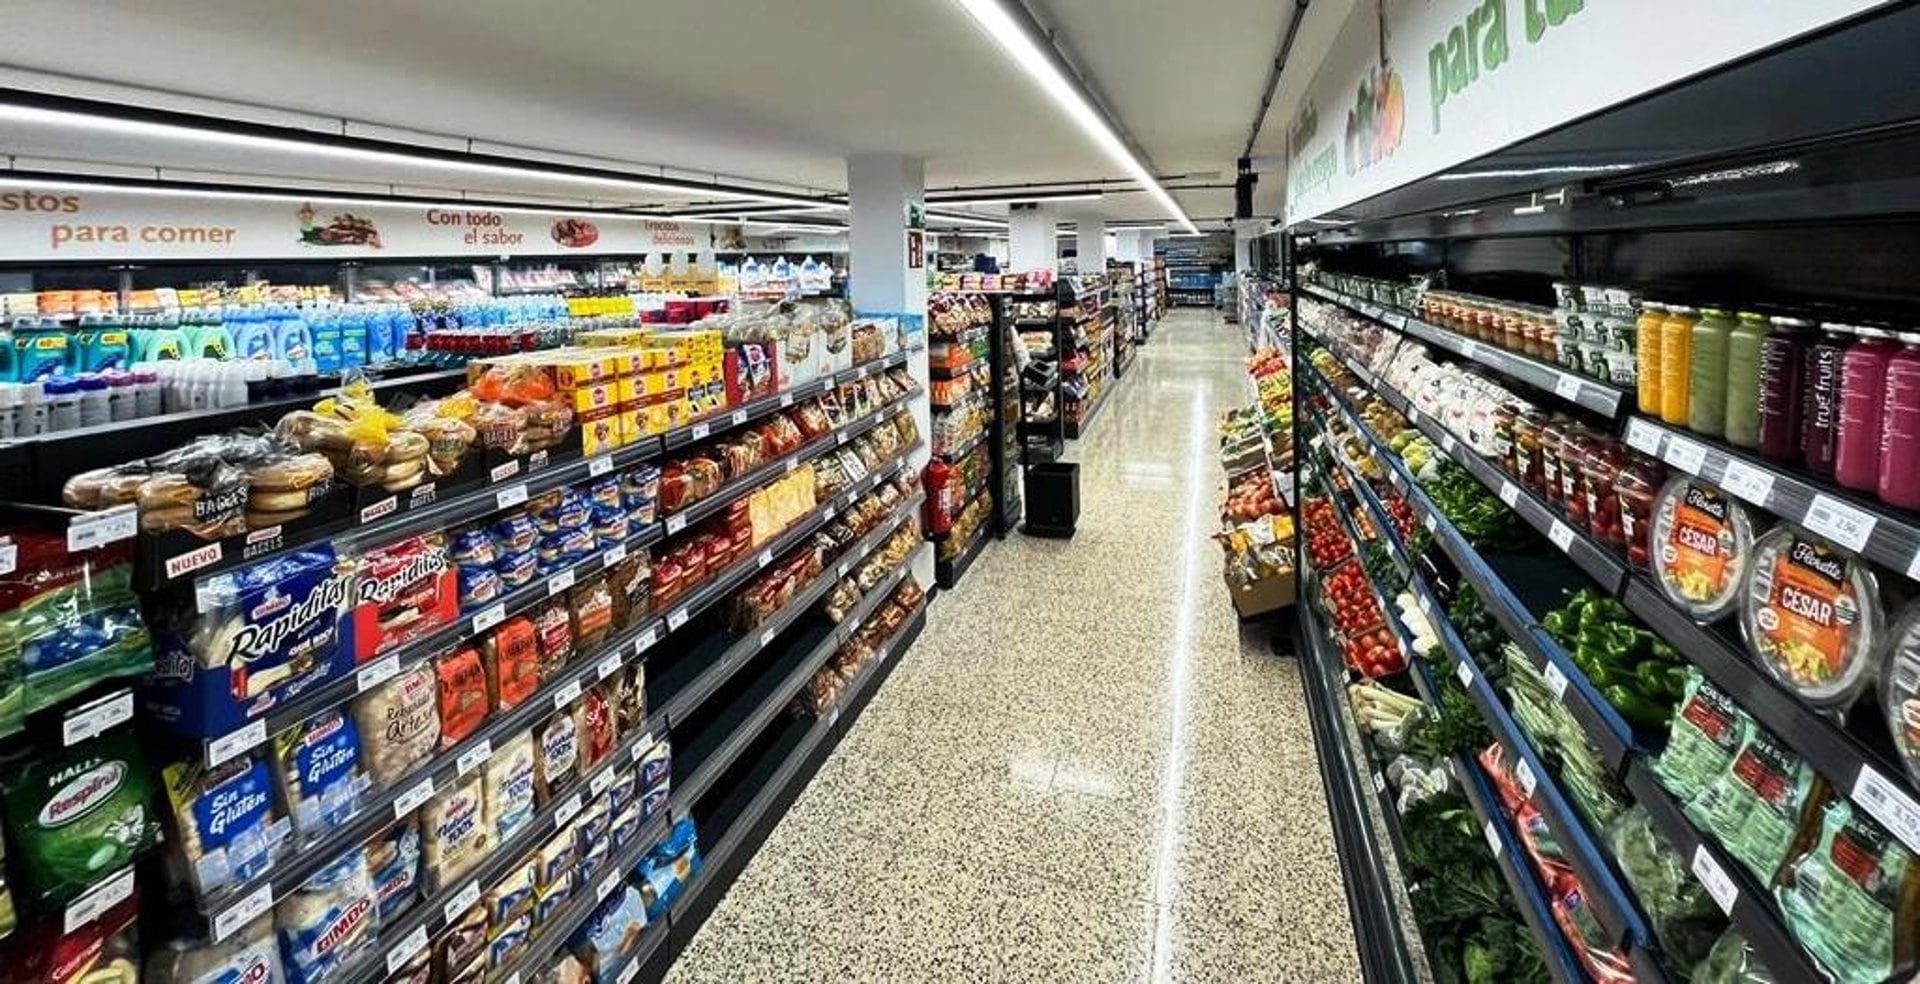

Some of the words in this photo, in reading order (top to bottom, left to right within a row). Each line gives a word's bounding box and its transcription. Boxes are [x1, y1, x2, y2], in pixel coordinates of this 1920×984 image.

[1428, 0, 1509, 134] para
[426, 208, 461, 225] Con
[465, 211, 502, 227] todo
[51, 224, 128, 249] para
[141, 225, 236, 245] comer
[464, 228, 478, 244] el
[482, 228, 524, 245] sabor
[1814, 350, 1833, 391] fruits
[1814, 393, 1831, 428] true
[170, 547, 217, 575] NUEVO
[225, 576, 348, 666] Rapiditas
[1781, 586, 1832, 627] CÉSAR
[308, 747, 356, 783] Gluten
[309, 744, 335, 764] Sin
[209, 790, 238, 815] Sin
[209, 791, 267, 835] Gluten
